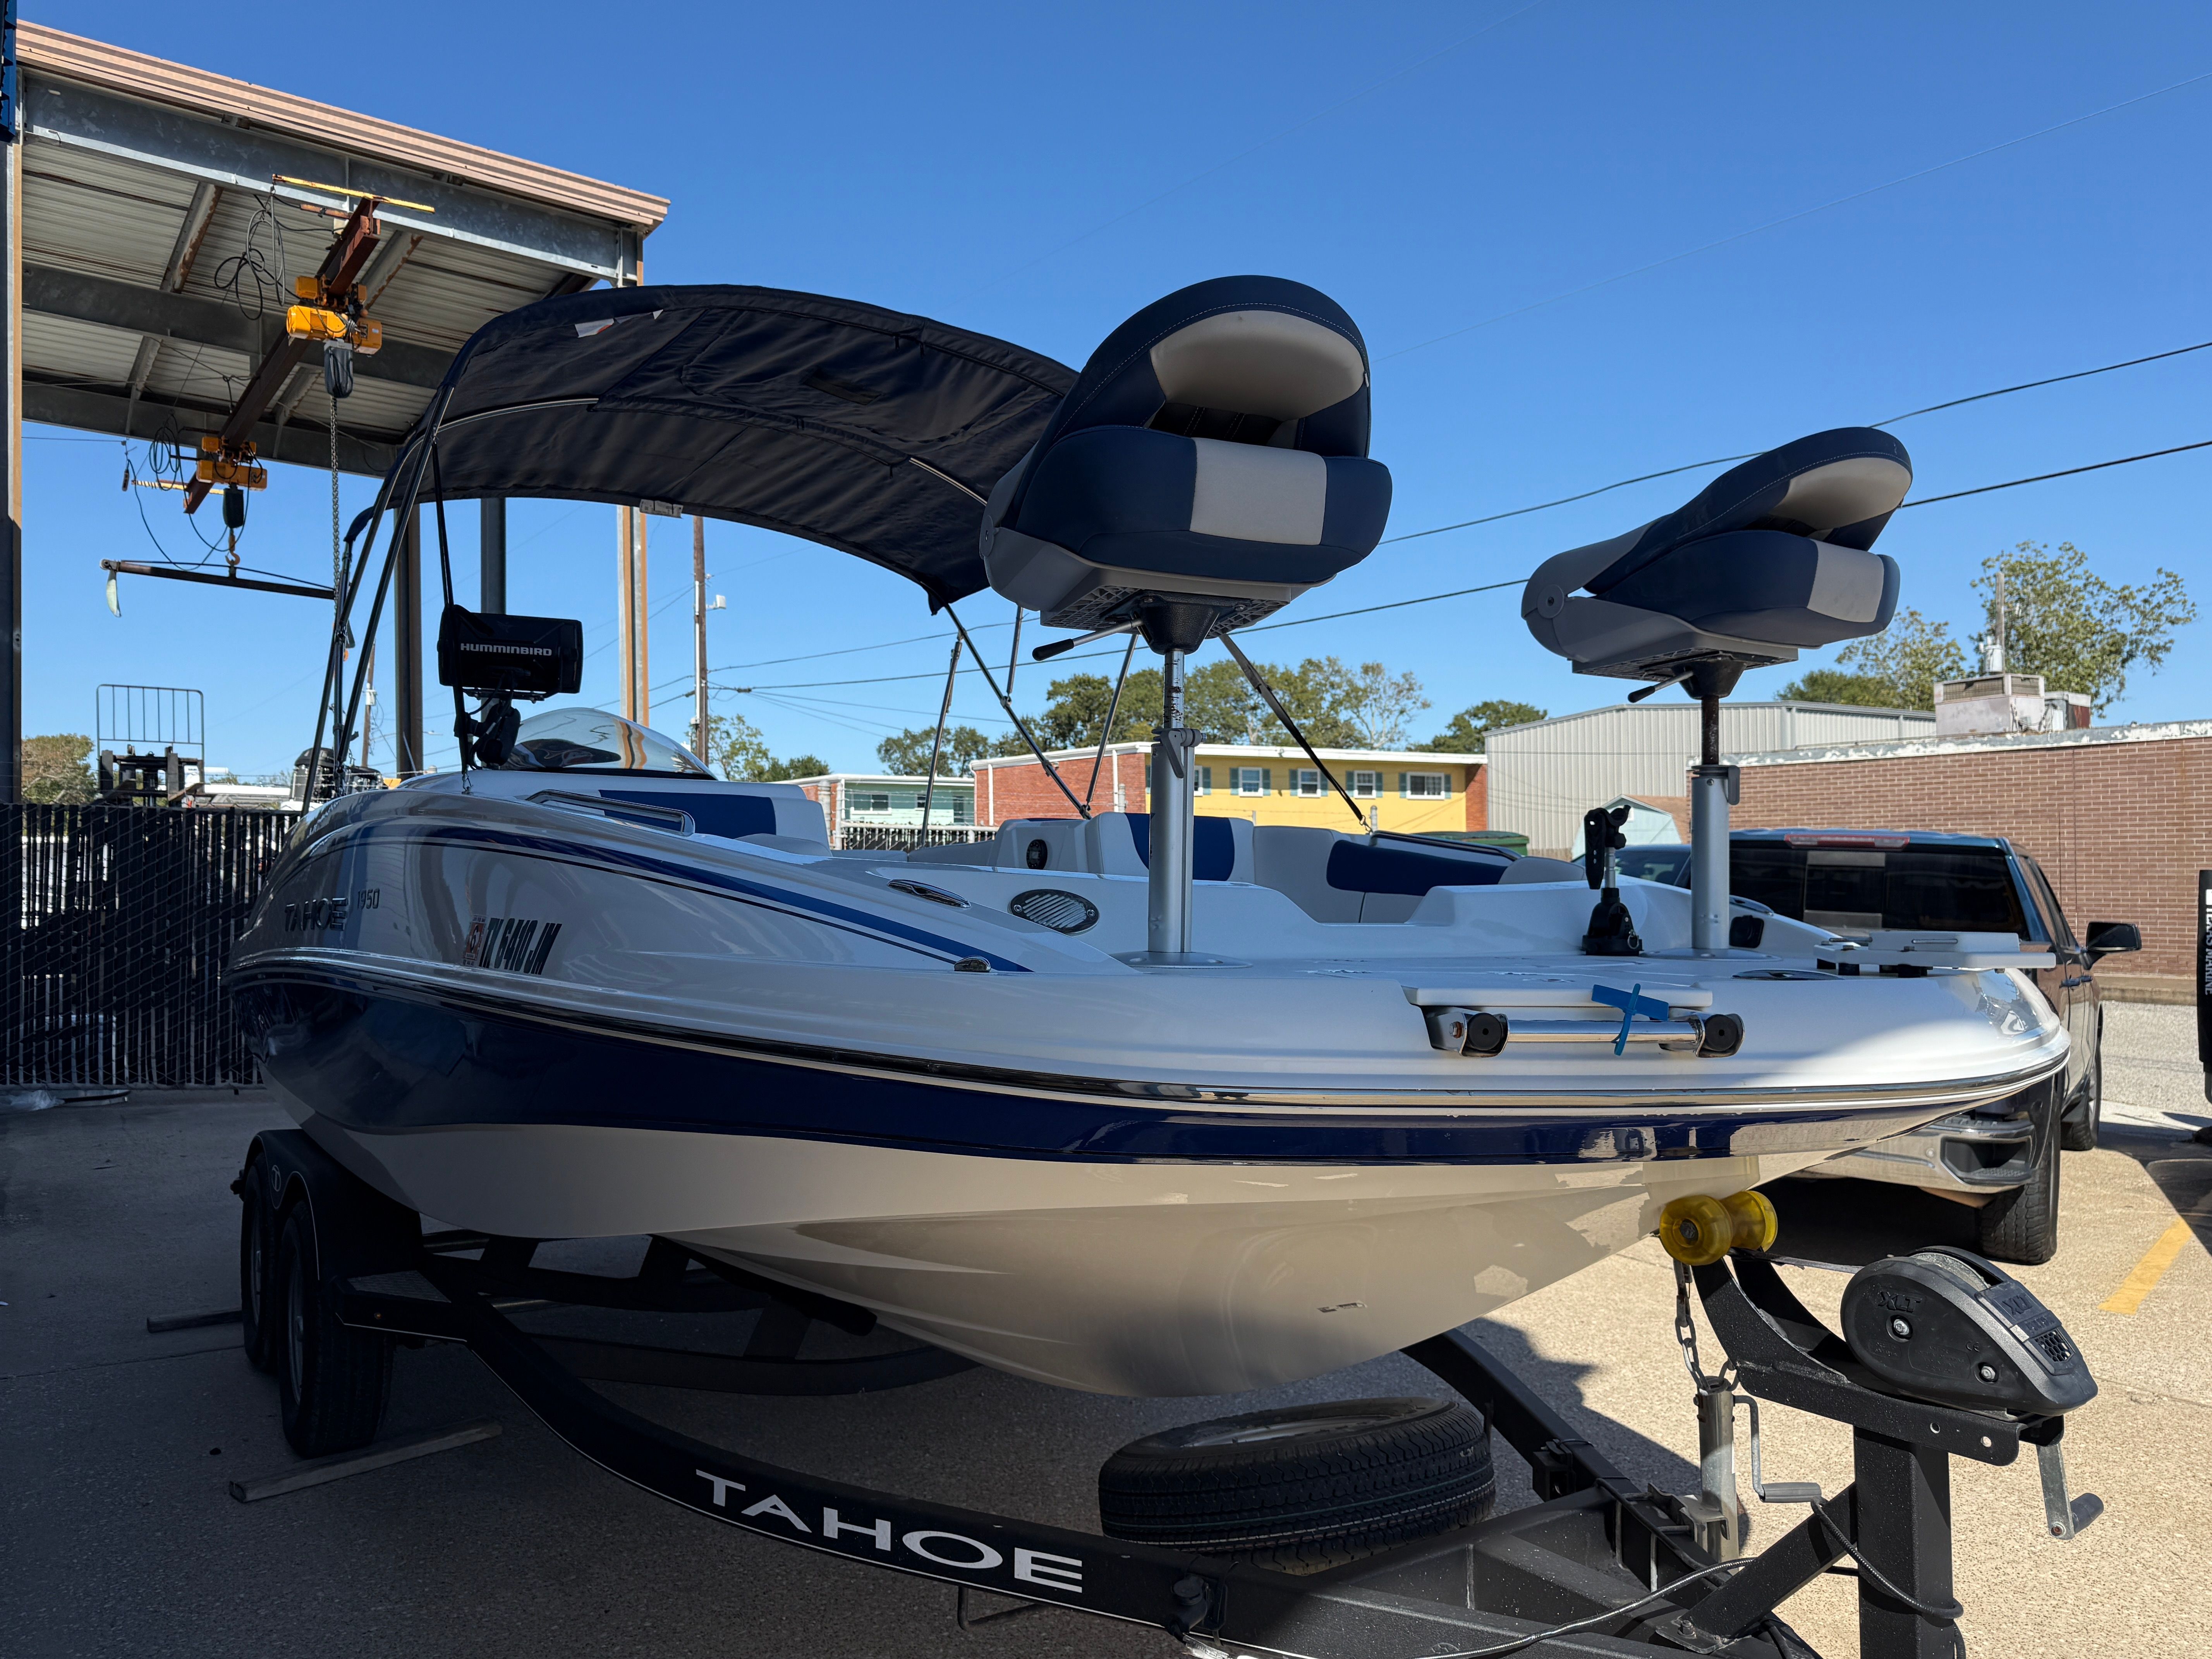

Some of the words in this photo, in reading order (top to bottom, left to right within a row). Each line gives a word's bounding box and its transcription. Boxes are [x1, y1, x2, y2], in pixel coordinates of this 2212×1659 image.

[460, 643, 552, 656] HUMMINBIRD
[357, 888, 380, 910] 1950
[284, 897, 349, 932] TAHOE
[479, 917, 504, 969] TX
[1877, 1290, 1923, 1313] XLT
[2002, 1295, 2032, 1315] XLT
[696, 1469, 1083, 1593] TAHOE
